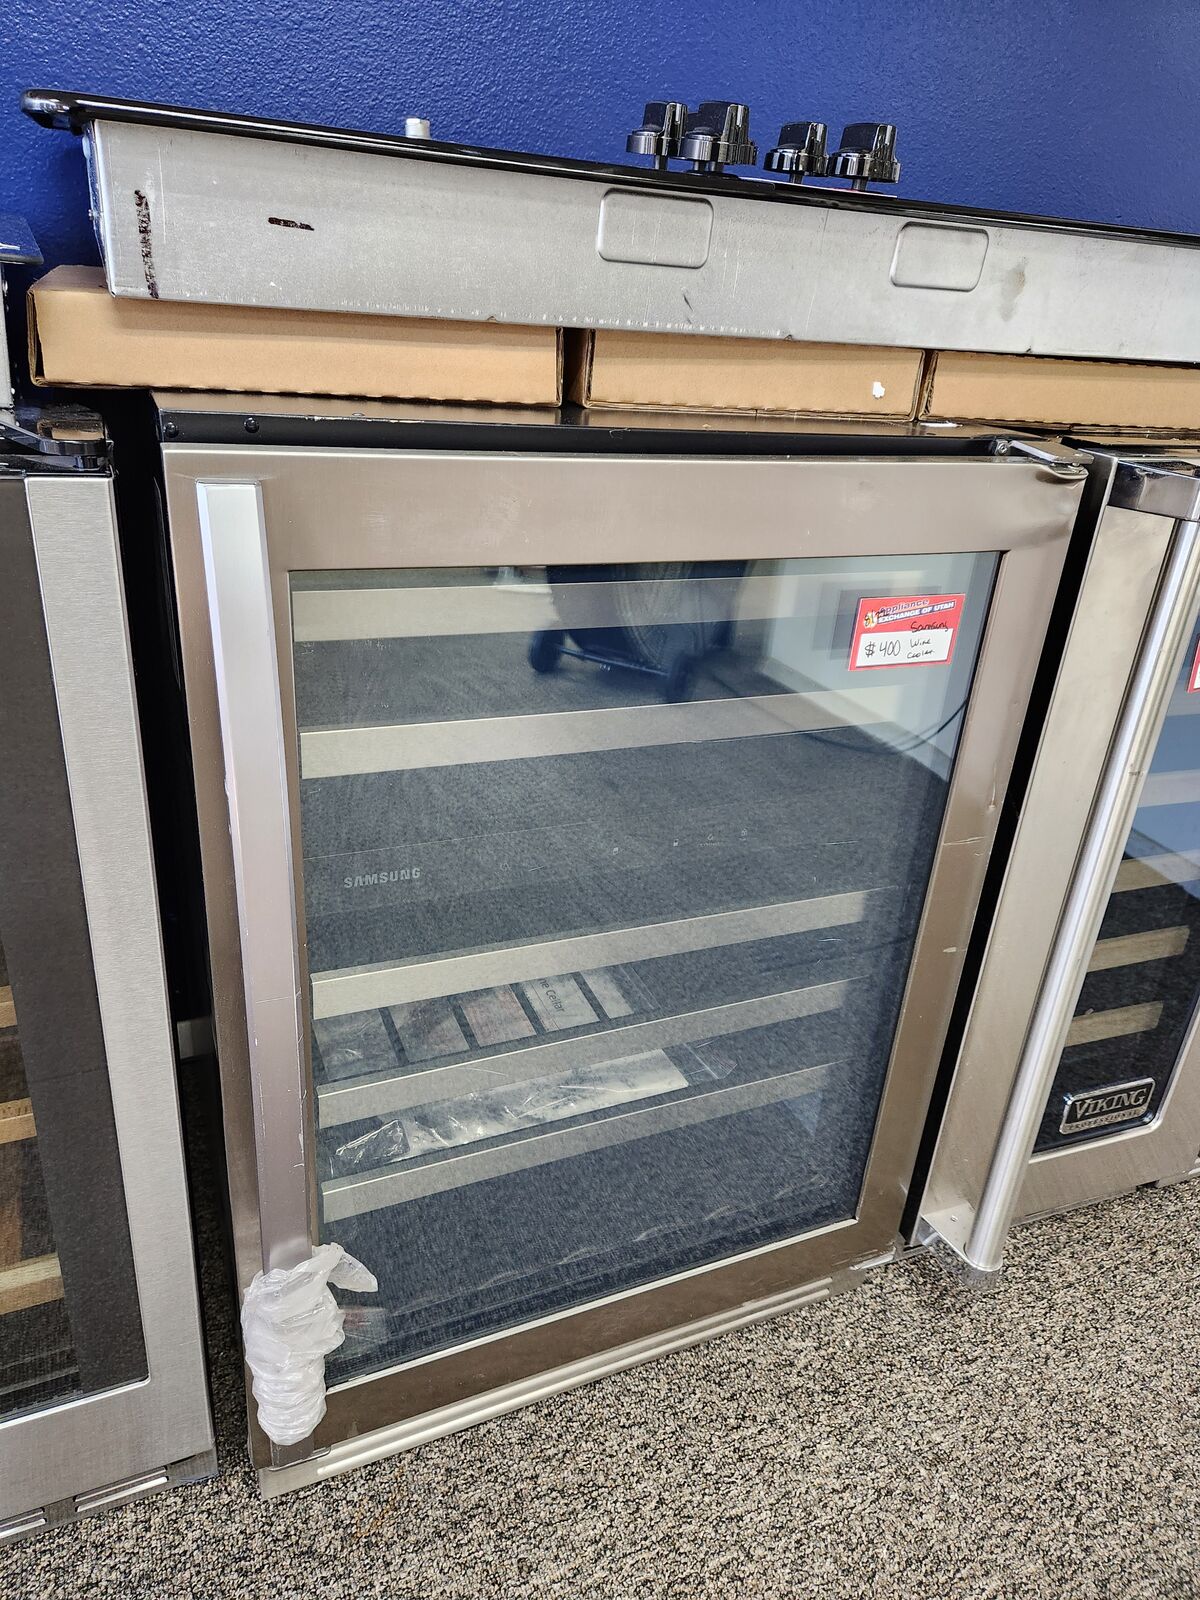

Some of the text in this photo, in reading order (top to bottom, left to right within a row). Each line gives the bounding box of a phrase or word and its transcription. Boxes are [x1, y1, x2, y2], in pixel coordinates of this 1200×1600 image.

[878, 601, 955, 624] EXCHANGE OF UTAH
[343, 867, 421, 888] SAMSUNG
[546, 989, 565, 1012] Cellar
[1075, 1088, 1147, 1120] VIKING
